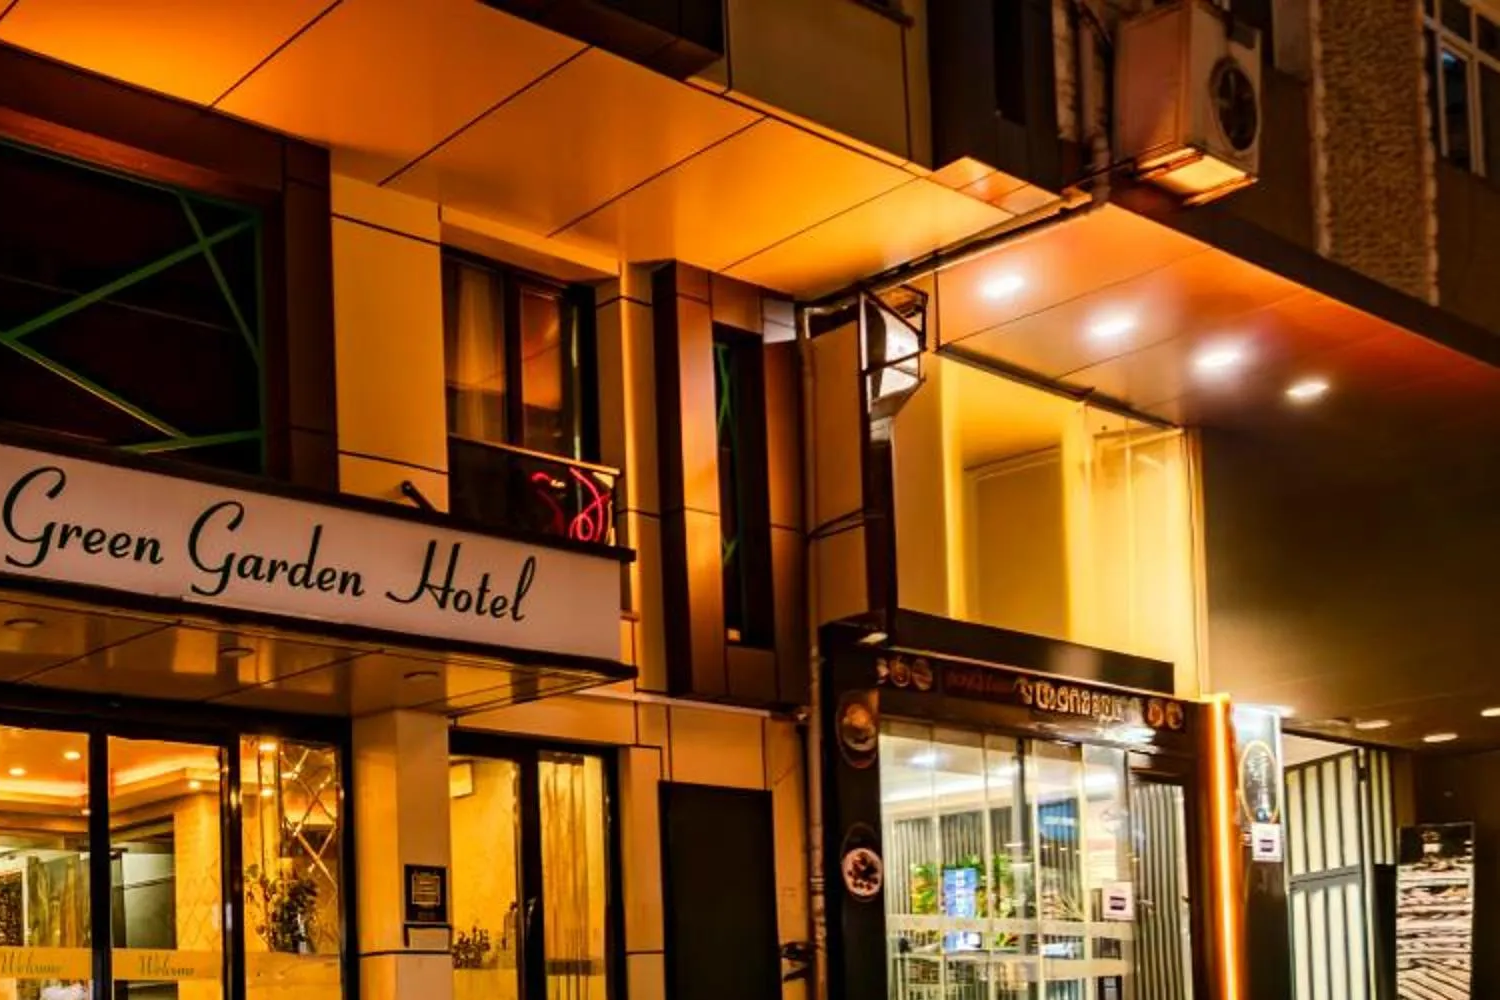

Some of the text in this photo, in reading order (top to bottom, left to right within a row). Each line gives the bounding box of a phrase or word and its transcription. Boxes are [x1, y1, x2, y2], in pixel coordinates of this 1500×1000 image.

[2, 466, 537, 622] Green Garden Hotel
